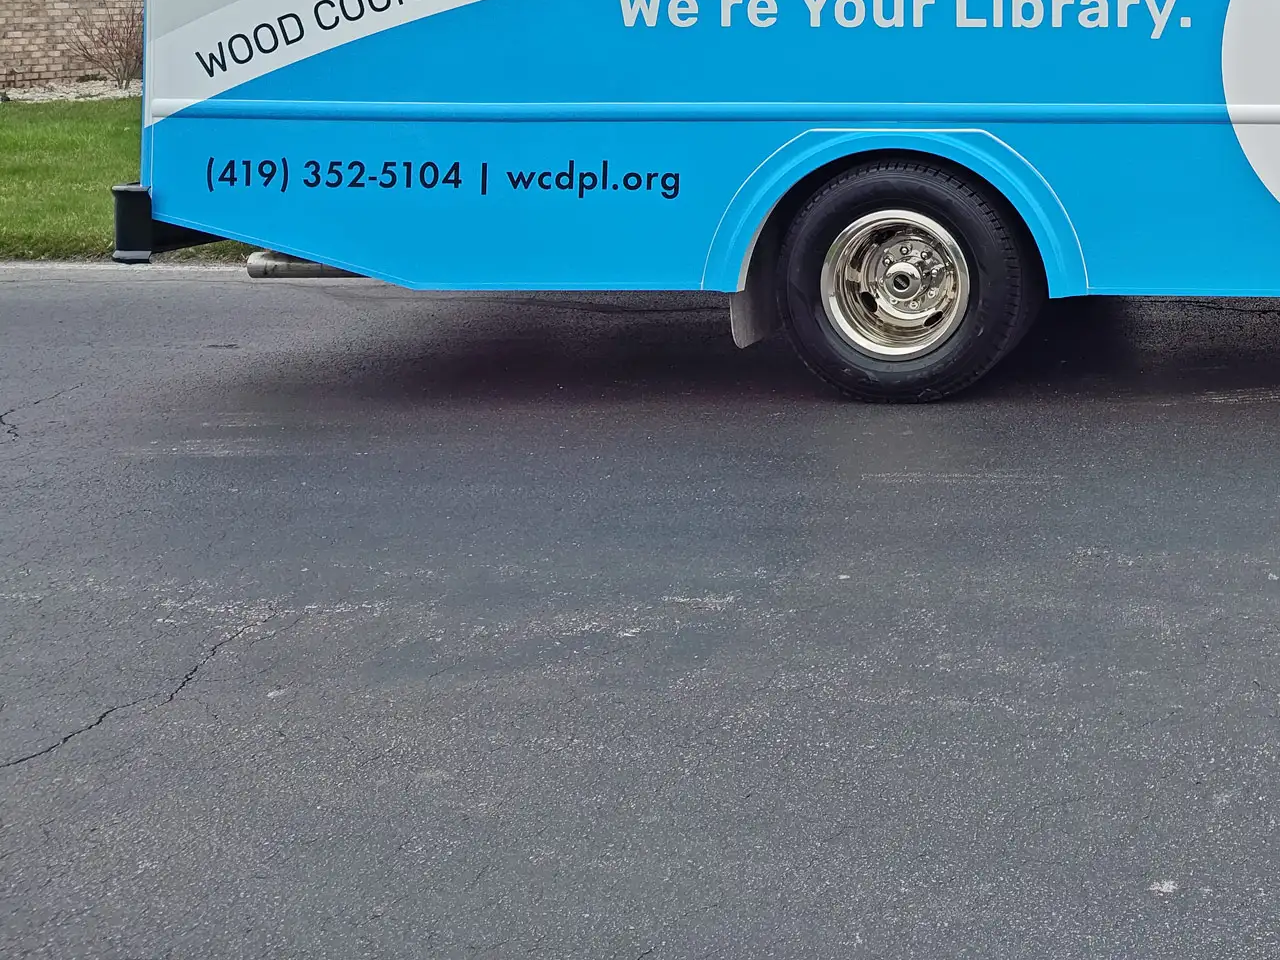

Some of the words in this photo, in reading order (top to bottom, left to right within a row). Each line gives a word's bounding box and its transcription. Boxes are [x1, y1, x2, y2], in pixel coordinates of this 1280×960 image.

[194, 11, 306, 79] WOOD
[206, 156, 289, 194] (419)
[303, 159, 463, 190] 352-5104
[506, 159, 681, 200] wcdpl.org
